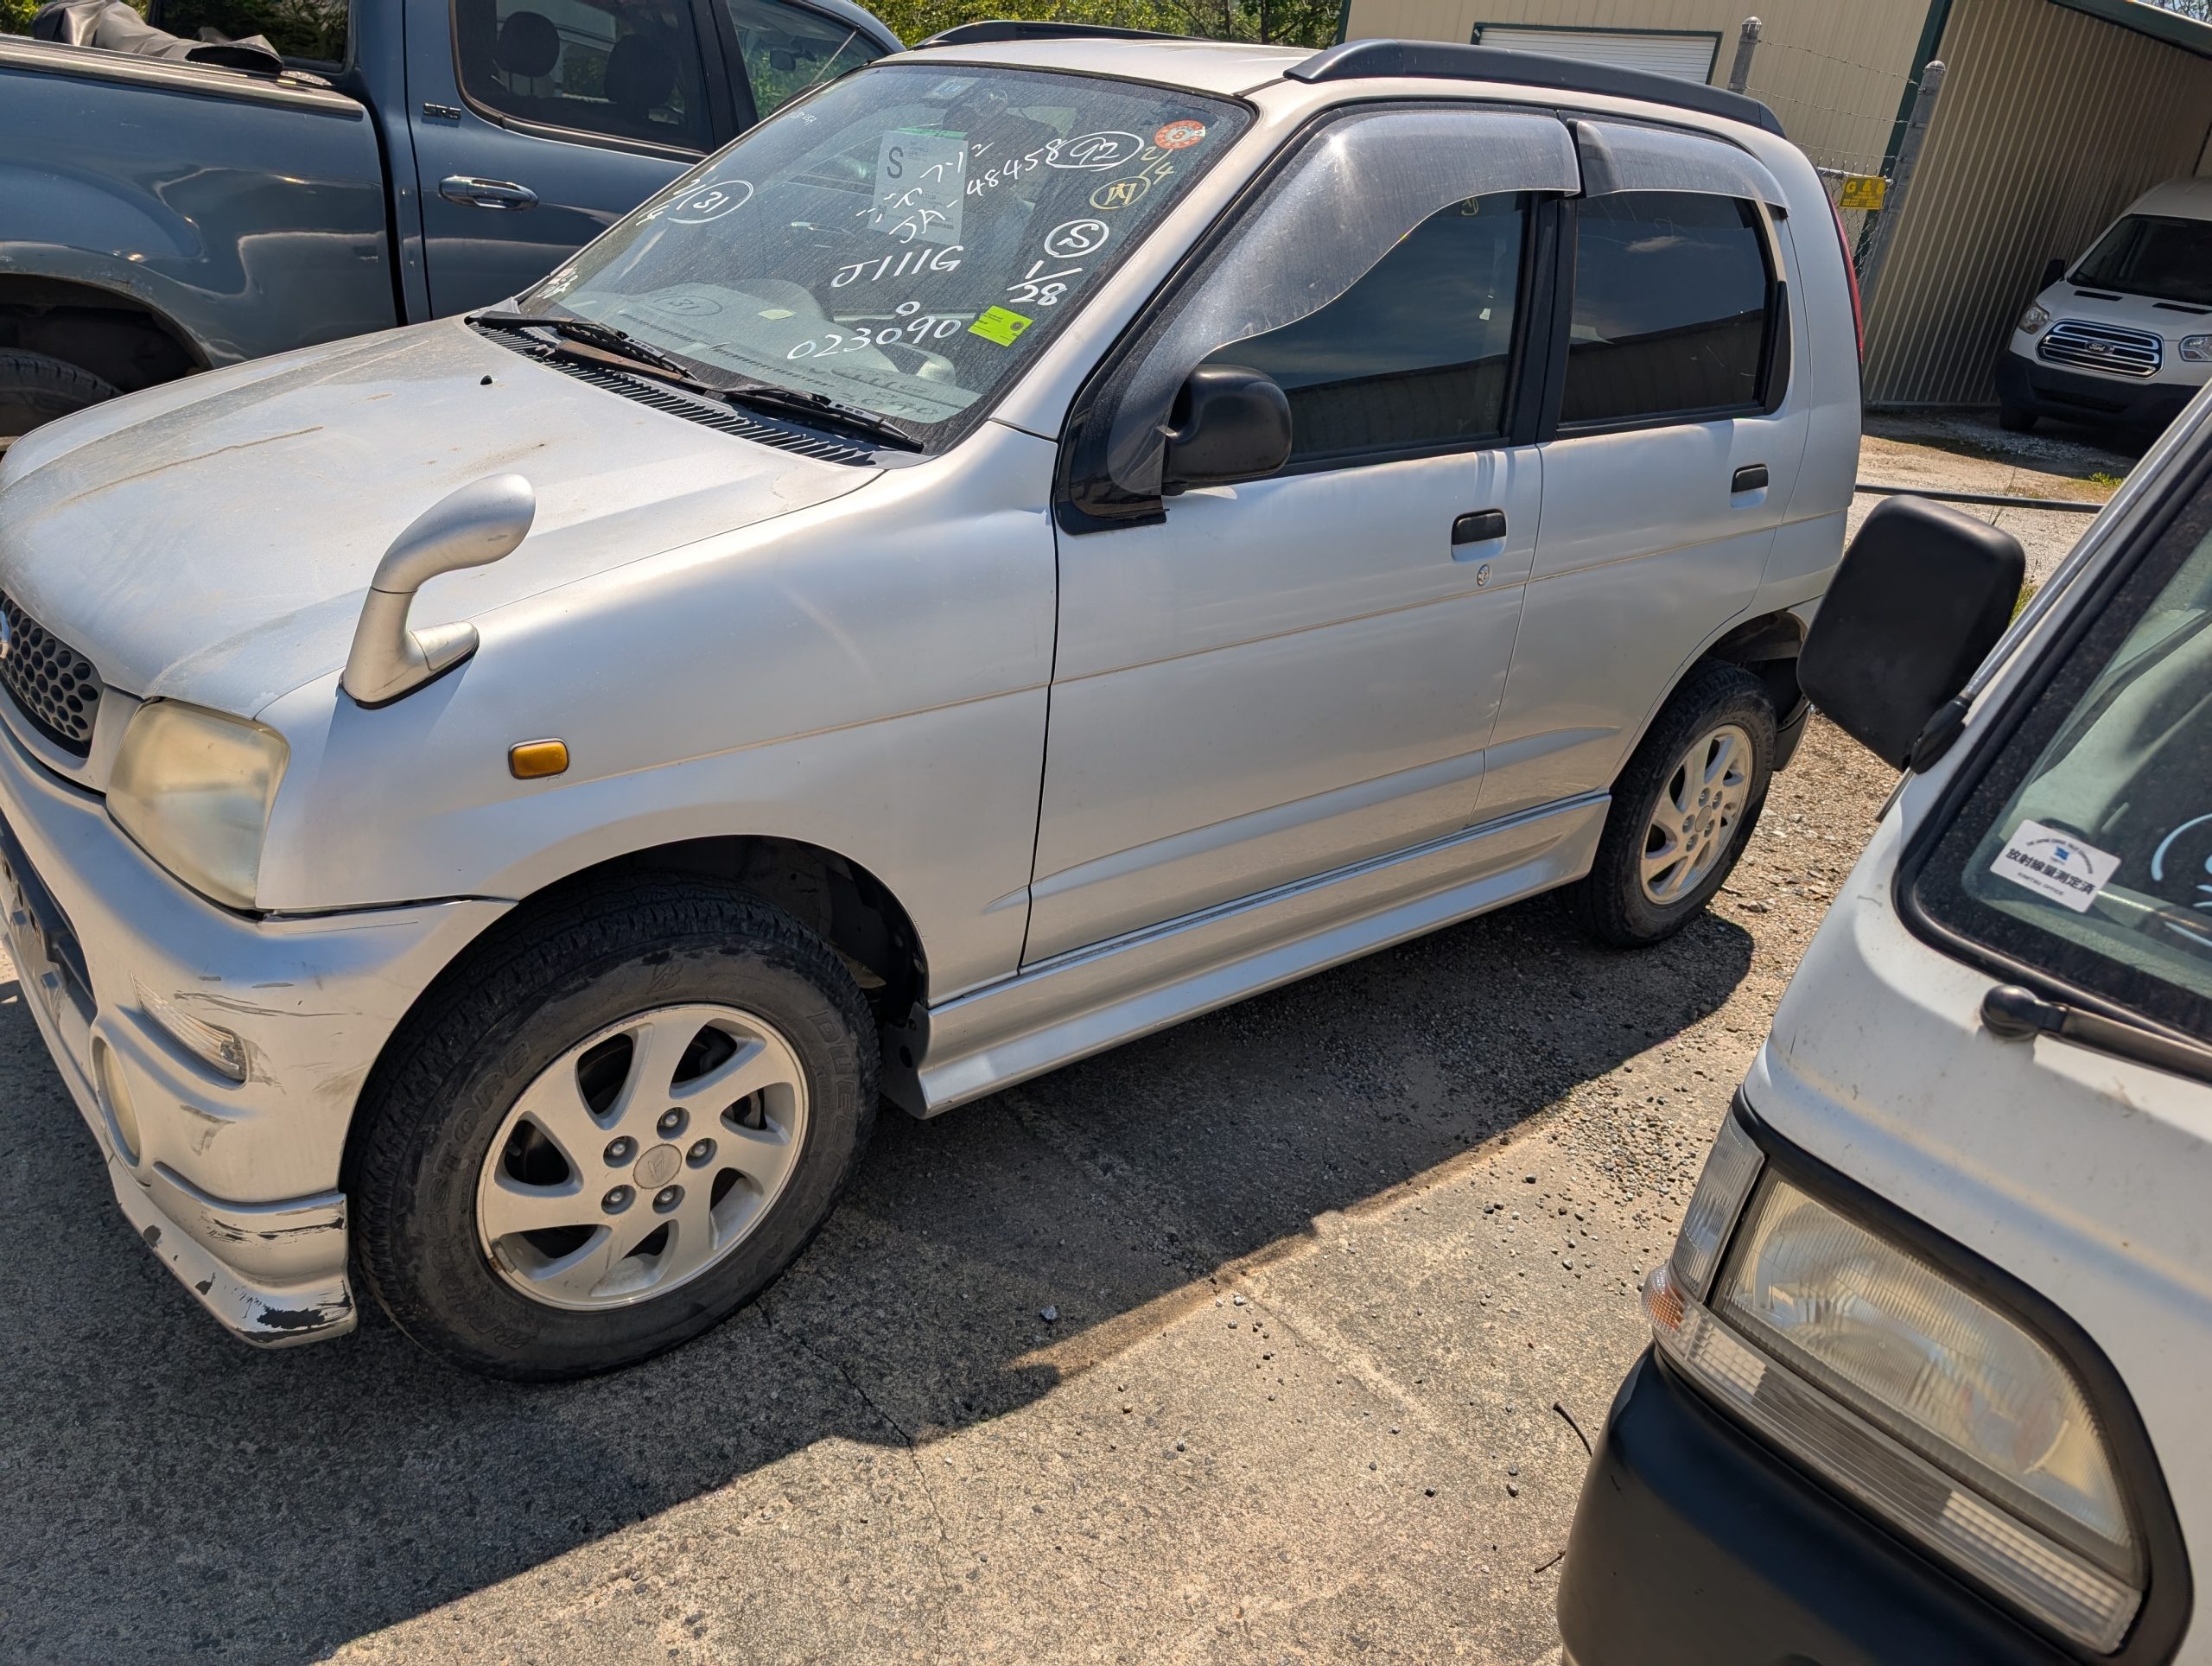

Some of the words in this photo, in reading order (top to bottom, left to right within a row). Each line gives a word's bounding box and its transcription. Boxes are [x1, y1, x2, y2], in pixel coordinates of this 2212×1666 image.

[423, 103, 461, 120] SR5
[887, 146, 904, 179] S
[1846, 181, 1858, 194] G
[1862, 179, 1872, 192] &
[2088, 342, 2106, 353] Ford
[2005, 847, 2097, 896] 放射線量測定済
